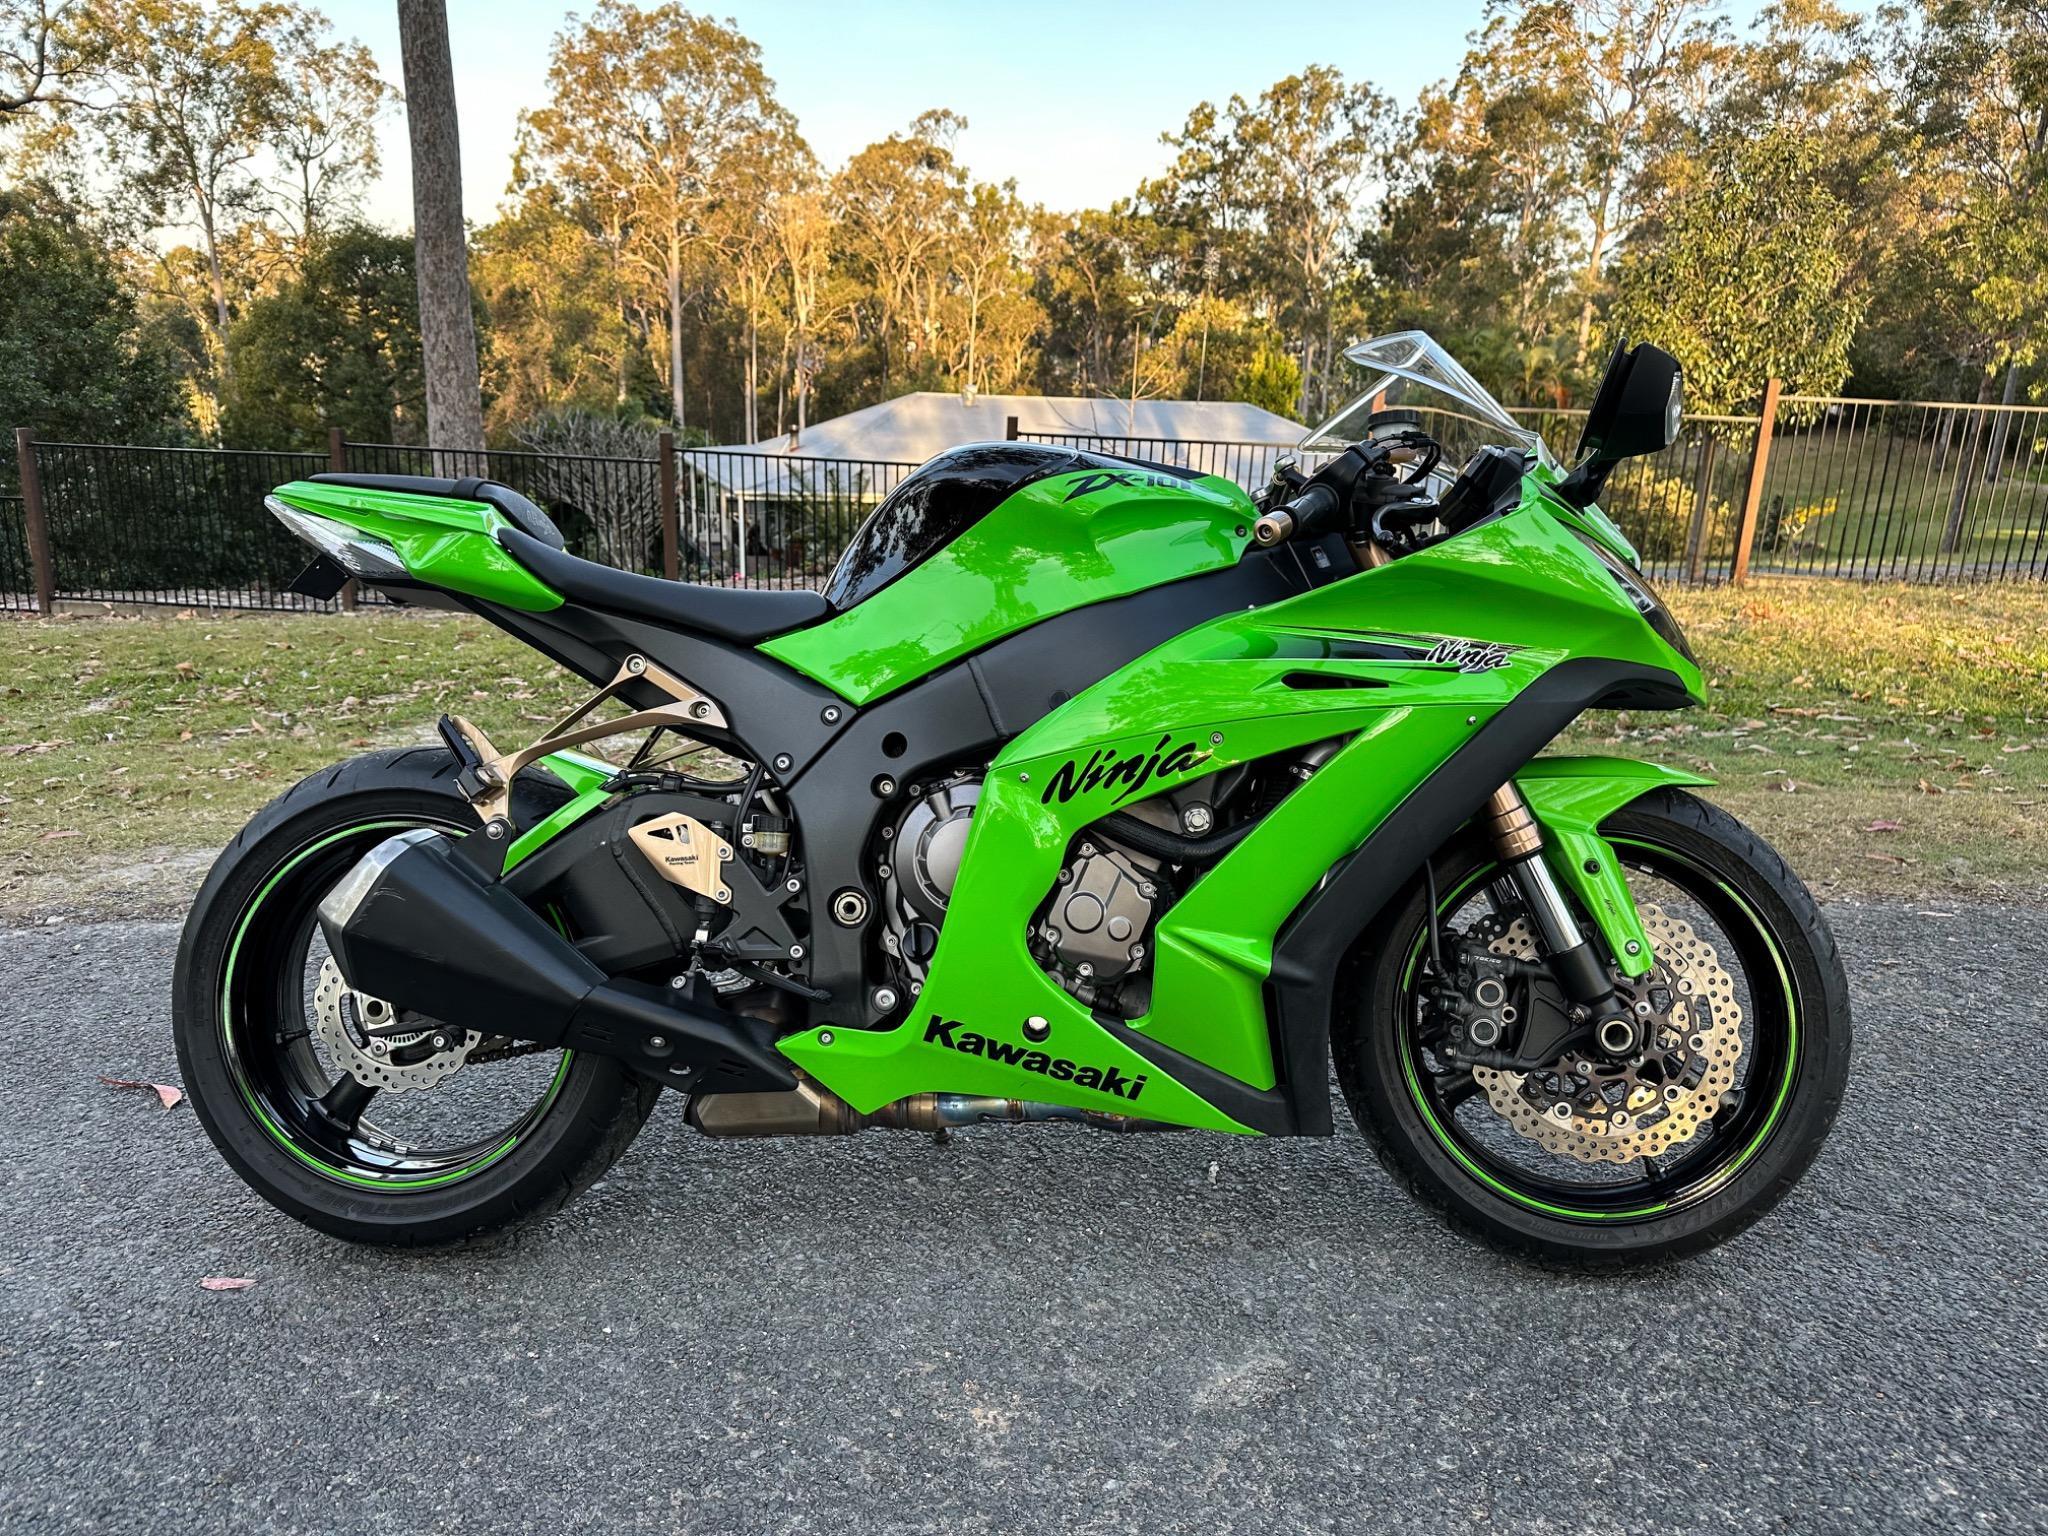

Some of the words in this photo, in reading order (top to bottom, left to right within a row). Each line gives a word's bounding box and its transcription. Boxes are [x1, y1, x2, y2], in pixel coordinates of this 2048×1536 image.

[1426, 638, 1512, 673] Ninja
[1041, 734, 1213, 806] Ninja
[922, 1013, 1148, 1101] Kawasaki
